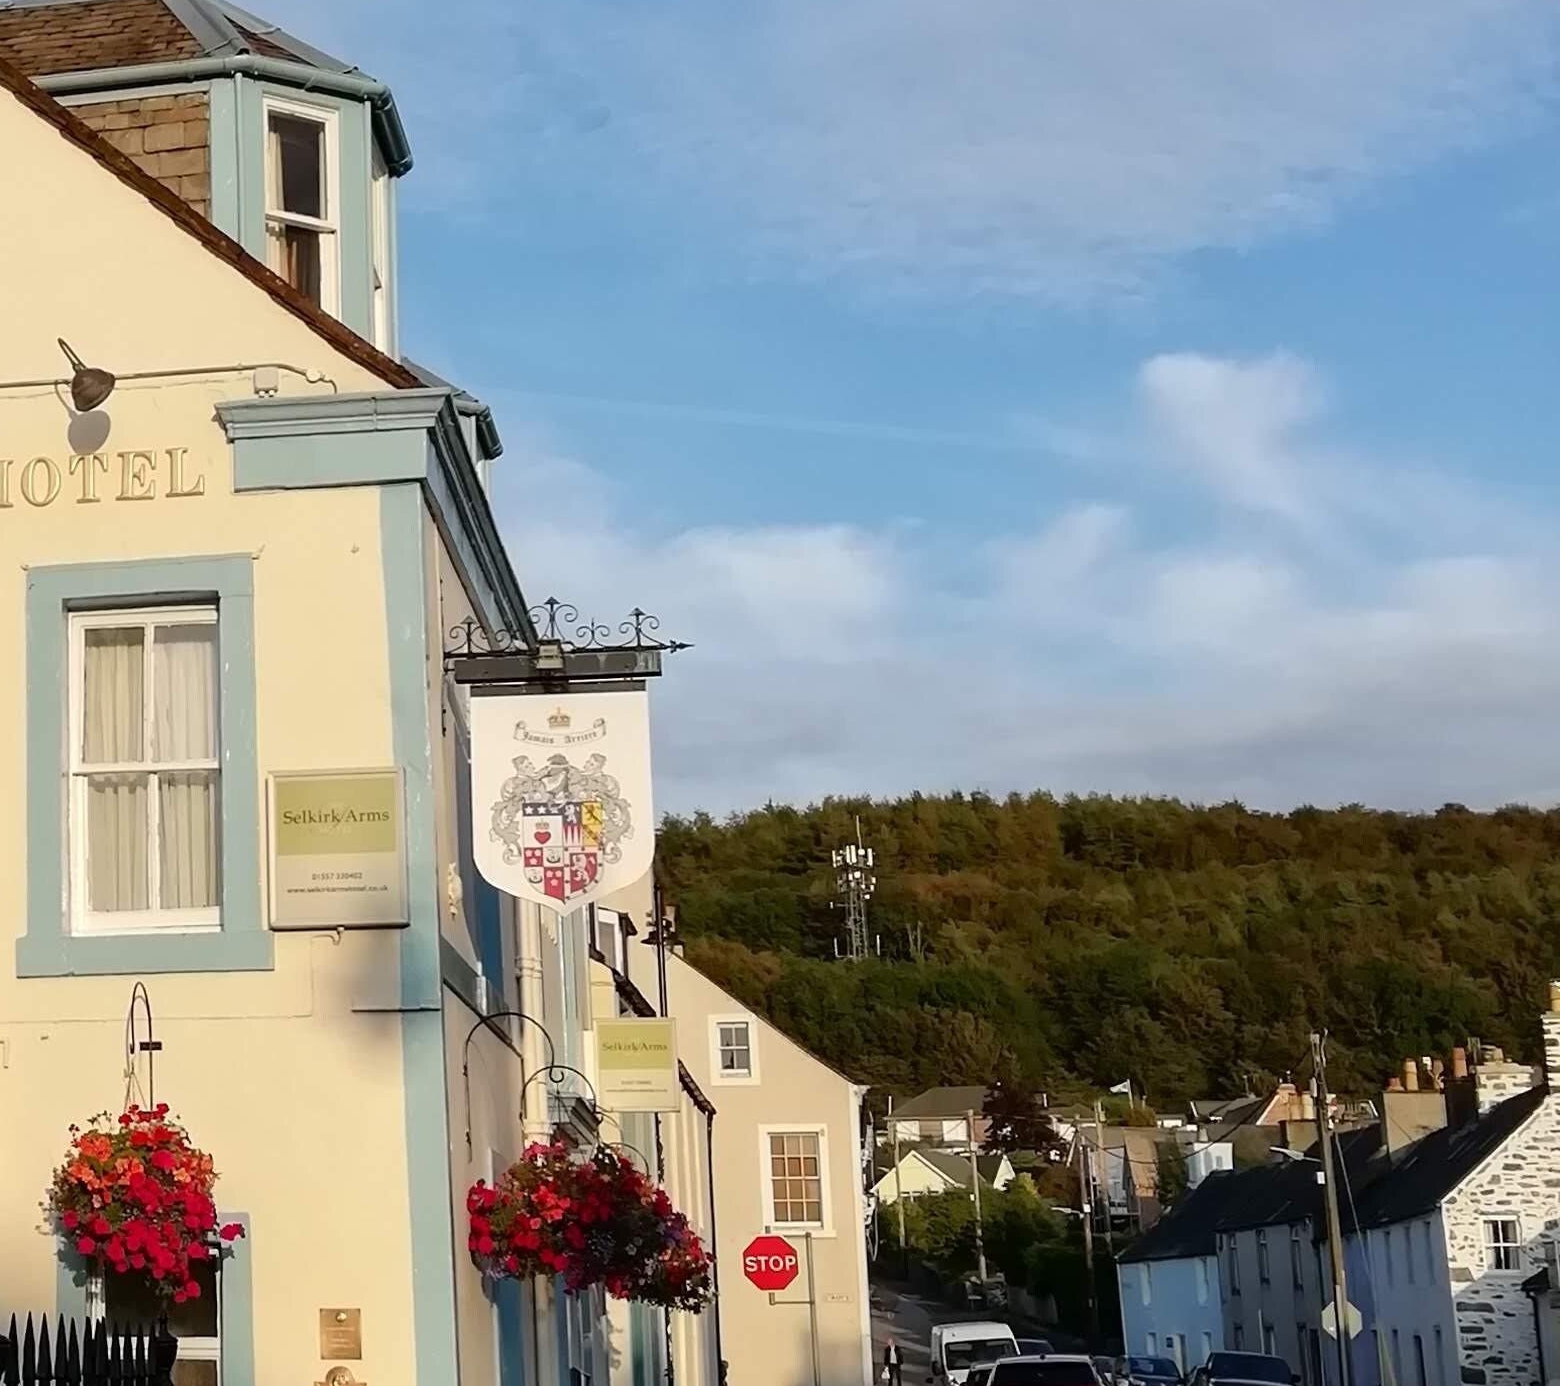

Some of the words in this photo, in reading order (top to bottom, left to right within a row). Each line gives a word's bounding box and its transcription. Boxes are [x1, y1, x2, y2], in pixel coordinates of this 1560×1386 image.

[283, 808, 341, 825] Selkirk
[345, 808, 390, 823] Arms
[640, 1041, 668, 1051] Arms
[745, 1255, 796, 1272] STOP
